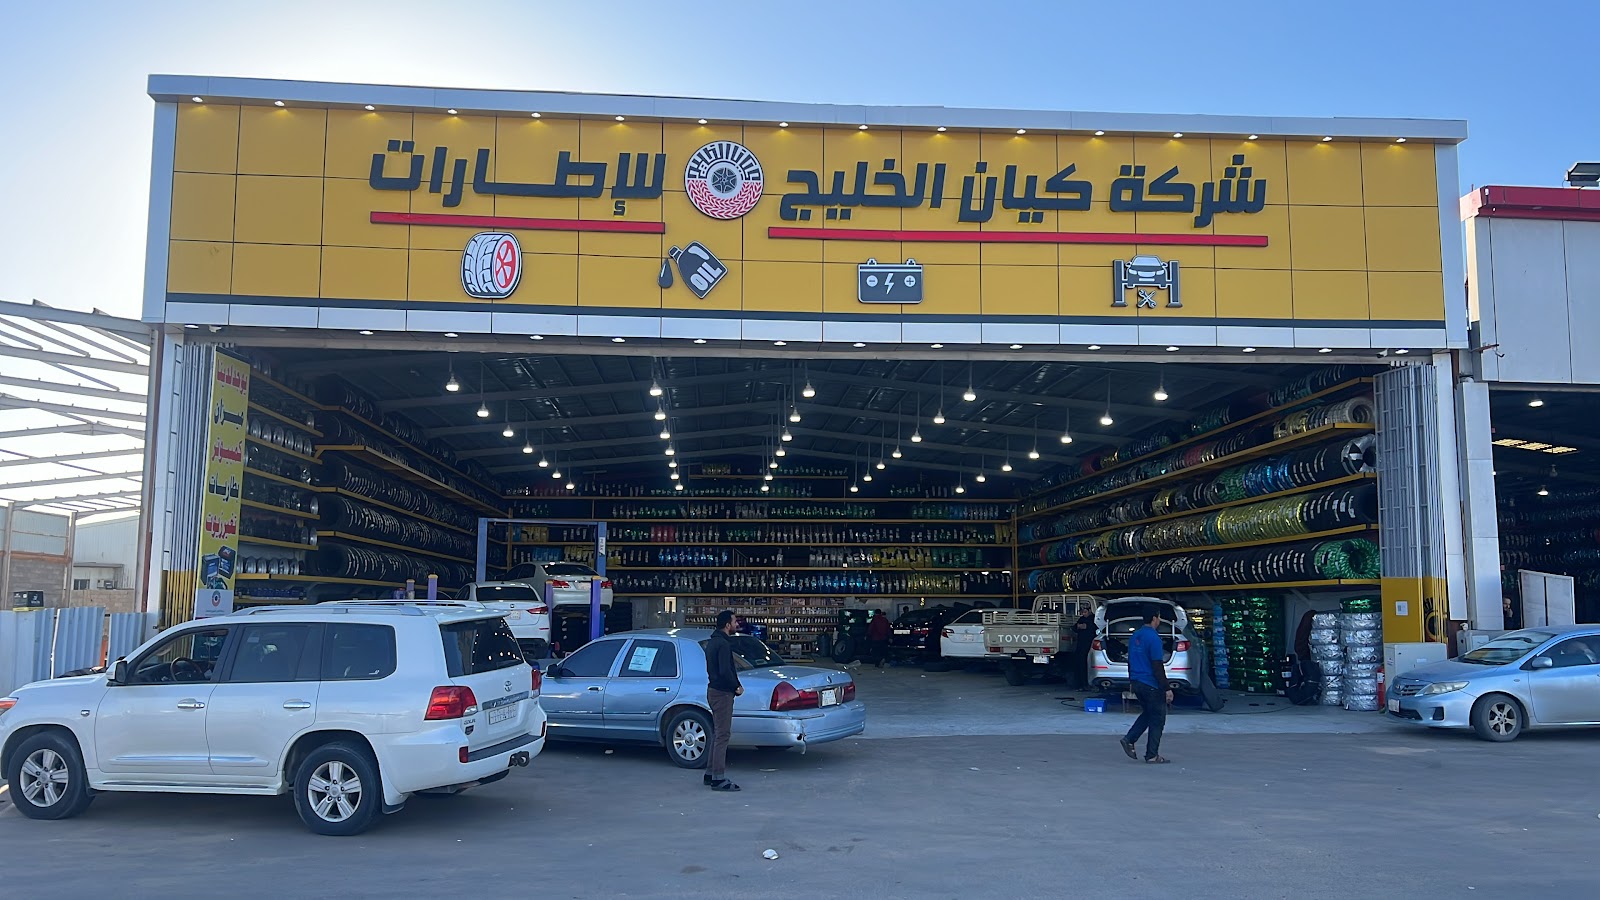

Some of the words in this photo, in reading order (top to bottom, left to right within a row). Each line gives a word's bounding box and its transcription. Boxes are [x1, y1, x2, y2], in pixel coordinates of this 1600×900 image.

[369, 139, 666, 216] للإطارات
[779, 158, 947, 221] الخليج
[957, 161, 1094, 224] كيان
[1108, 154, 1266, 228] شركة
[690, 261, 722, 290] OIL
[213, 398, 244, 430] ميزان
[211, 437, 243, 464] كمبيوتر
[208, 472, 240, 503] بطاريات
[998, 634, 1045, 643] TOYOTA
